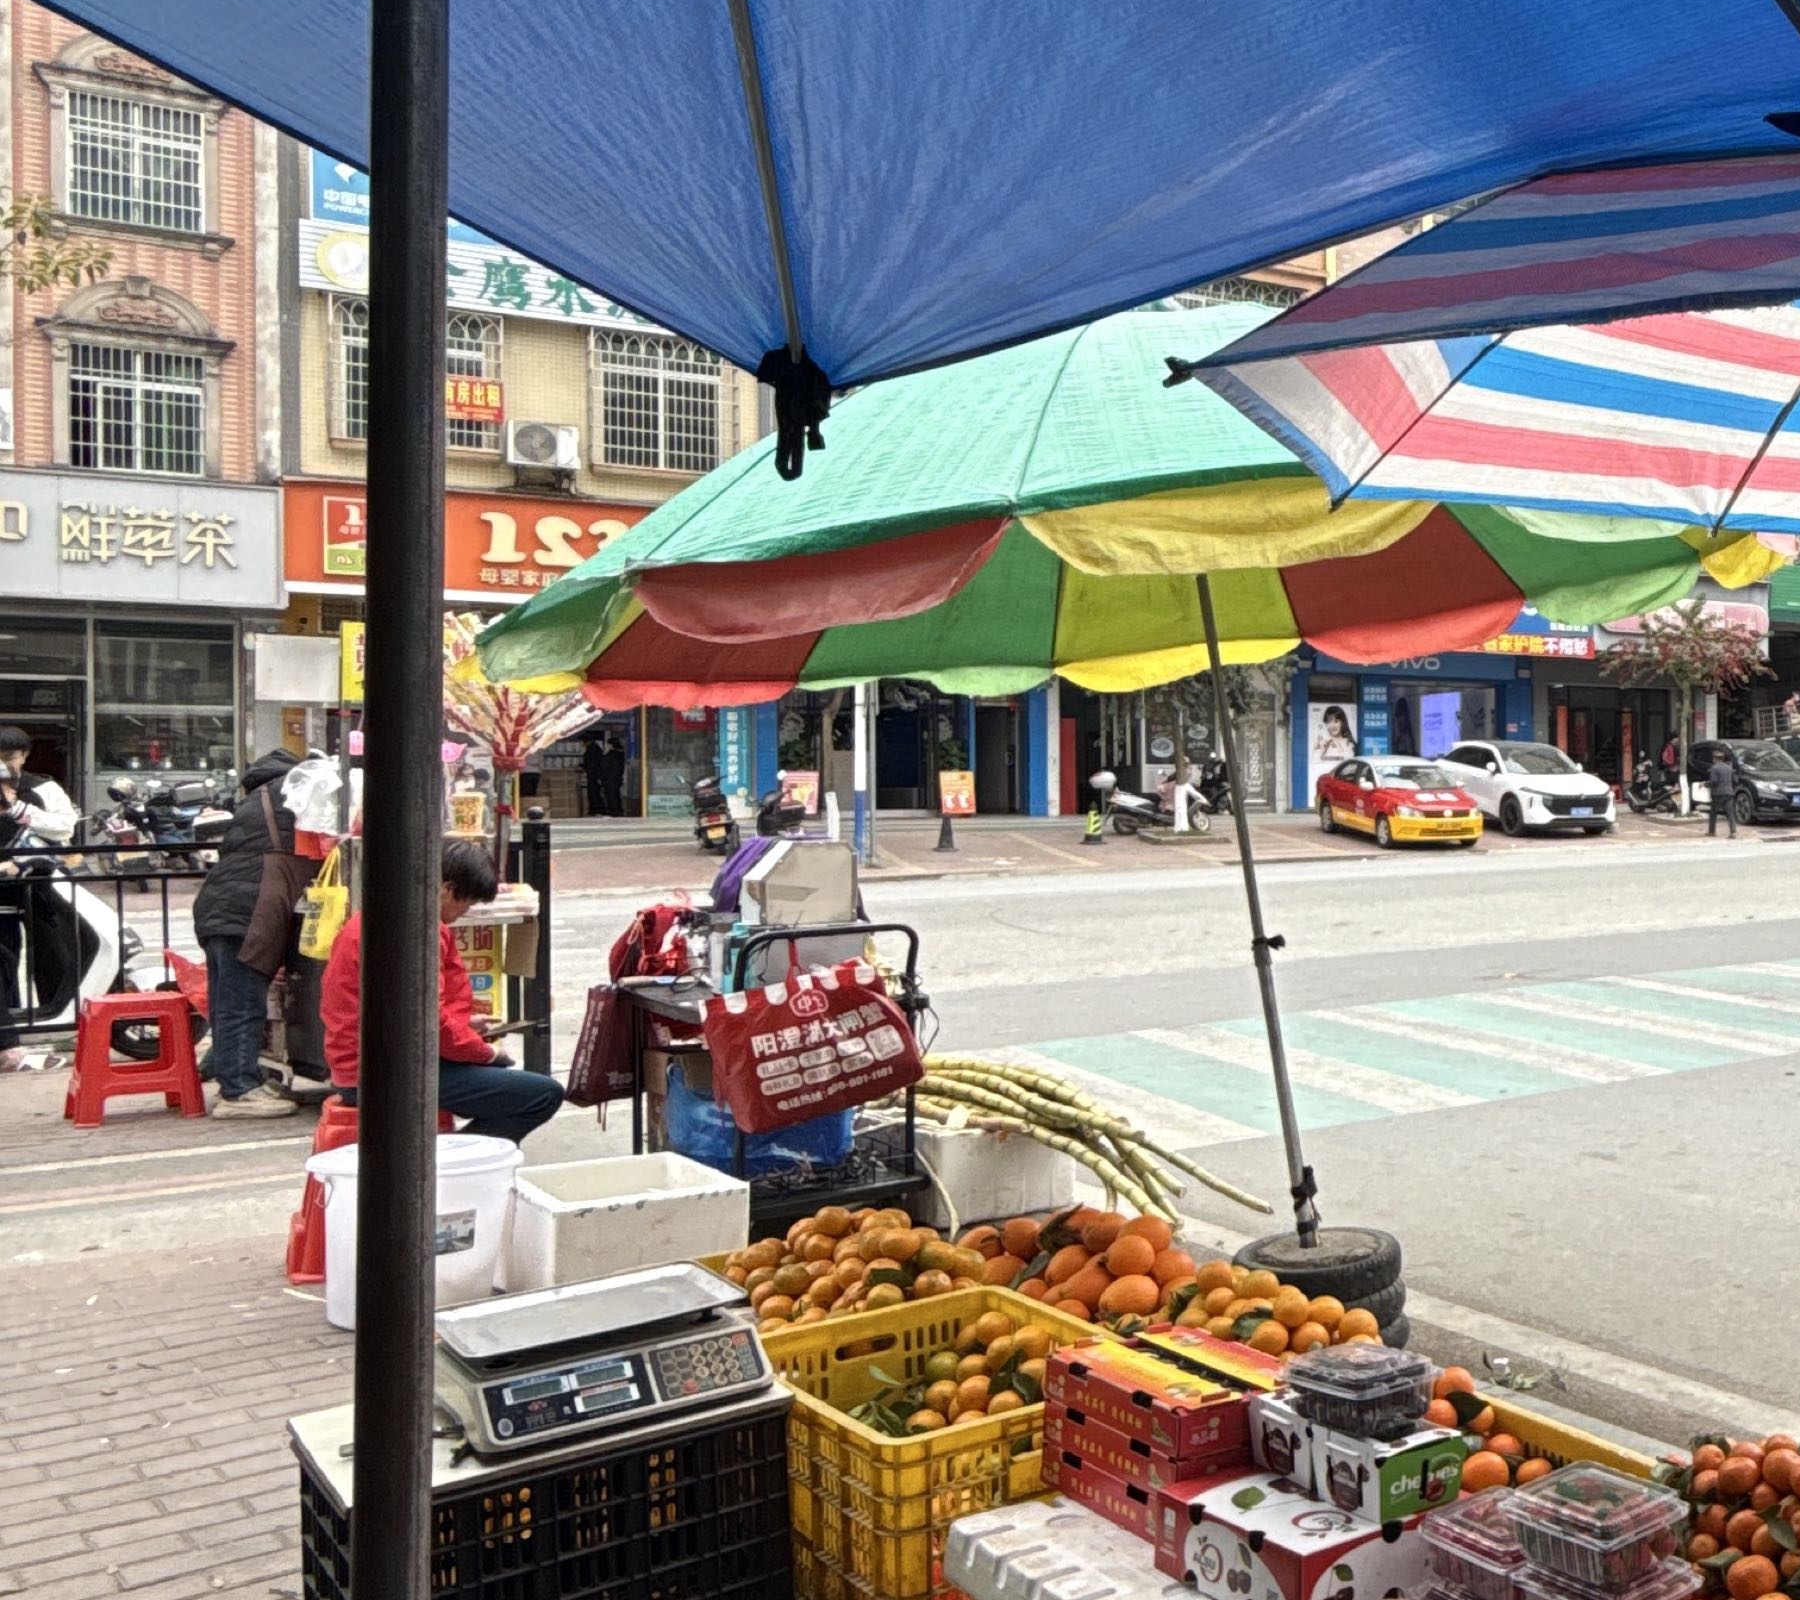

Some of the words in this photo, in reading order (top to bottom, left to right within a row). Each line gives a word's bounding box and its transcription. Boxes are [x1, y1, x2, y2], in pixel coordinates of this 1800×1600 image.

[446, 256, 655, 325] 鹰水
[61, 500, 238, 569] 鲜萃茶
[750, 1001, 888, 1059] 阳澄湖大闸蟹
